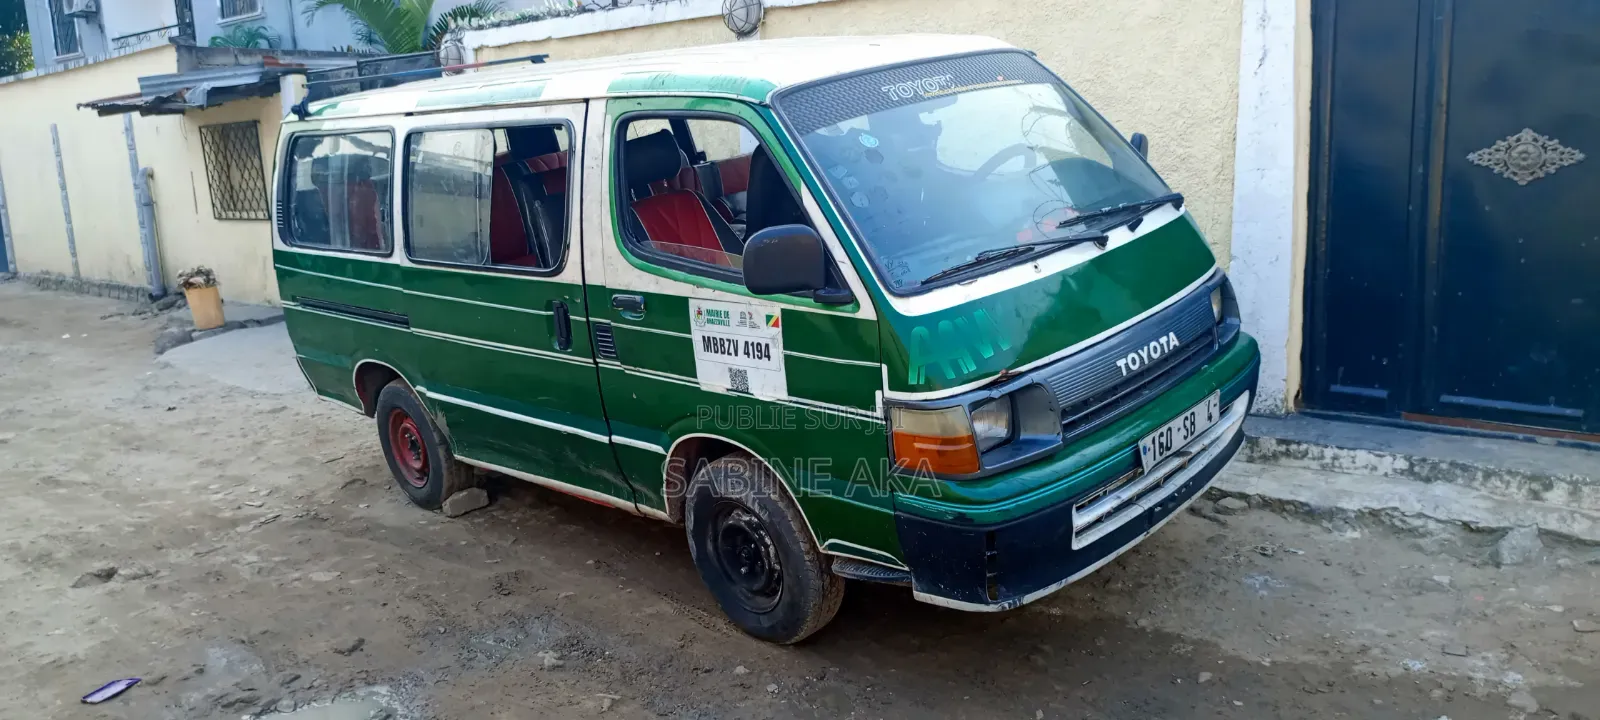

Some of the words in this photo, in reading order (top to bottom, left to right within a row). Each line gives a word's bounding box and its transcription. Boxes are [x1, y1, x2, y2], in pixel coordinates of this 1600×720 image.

[702, 335, 739, 357] MBBZV
[743, 341, 771, 361] 4194
[1116, 331, 1180, 377] TOYOTA
